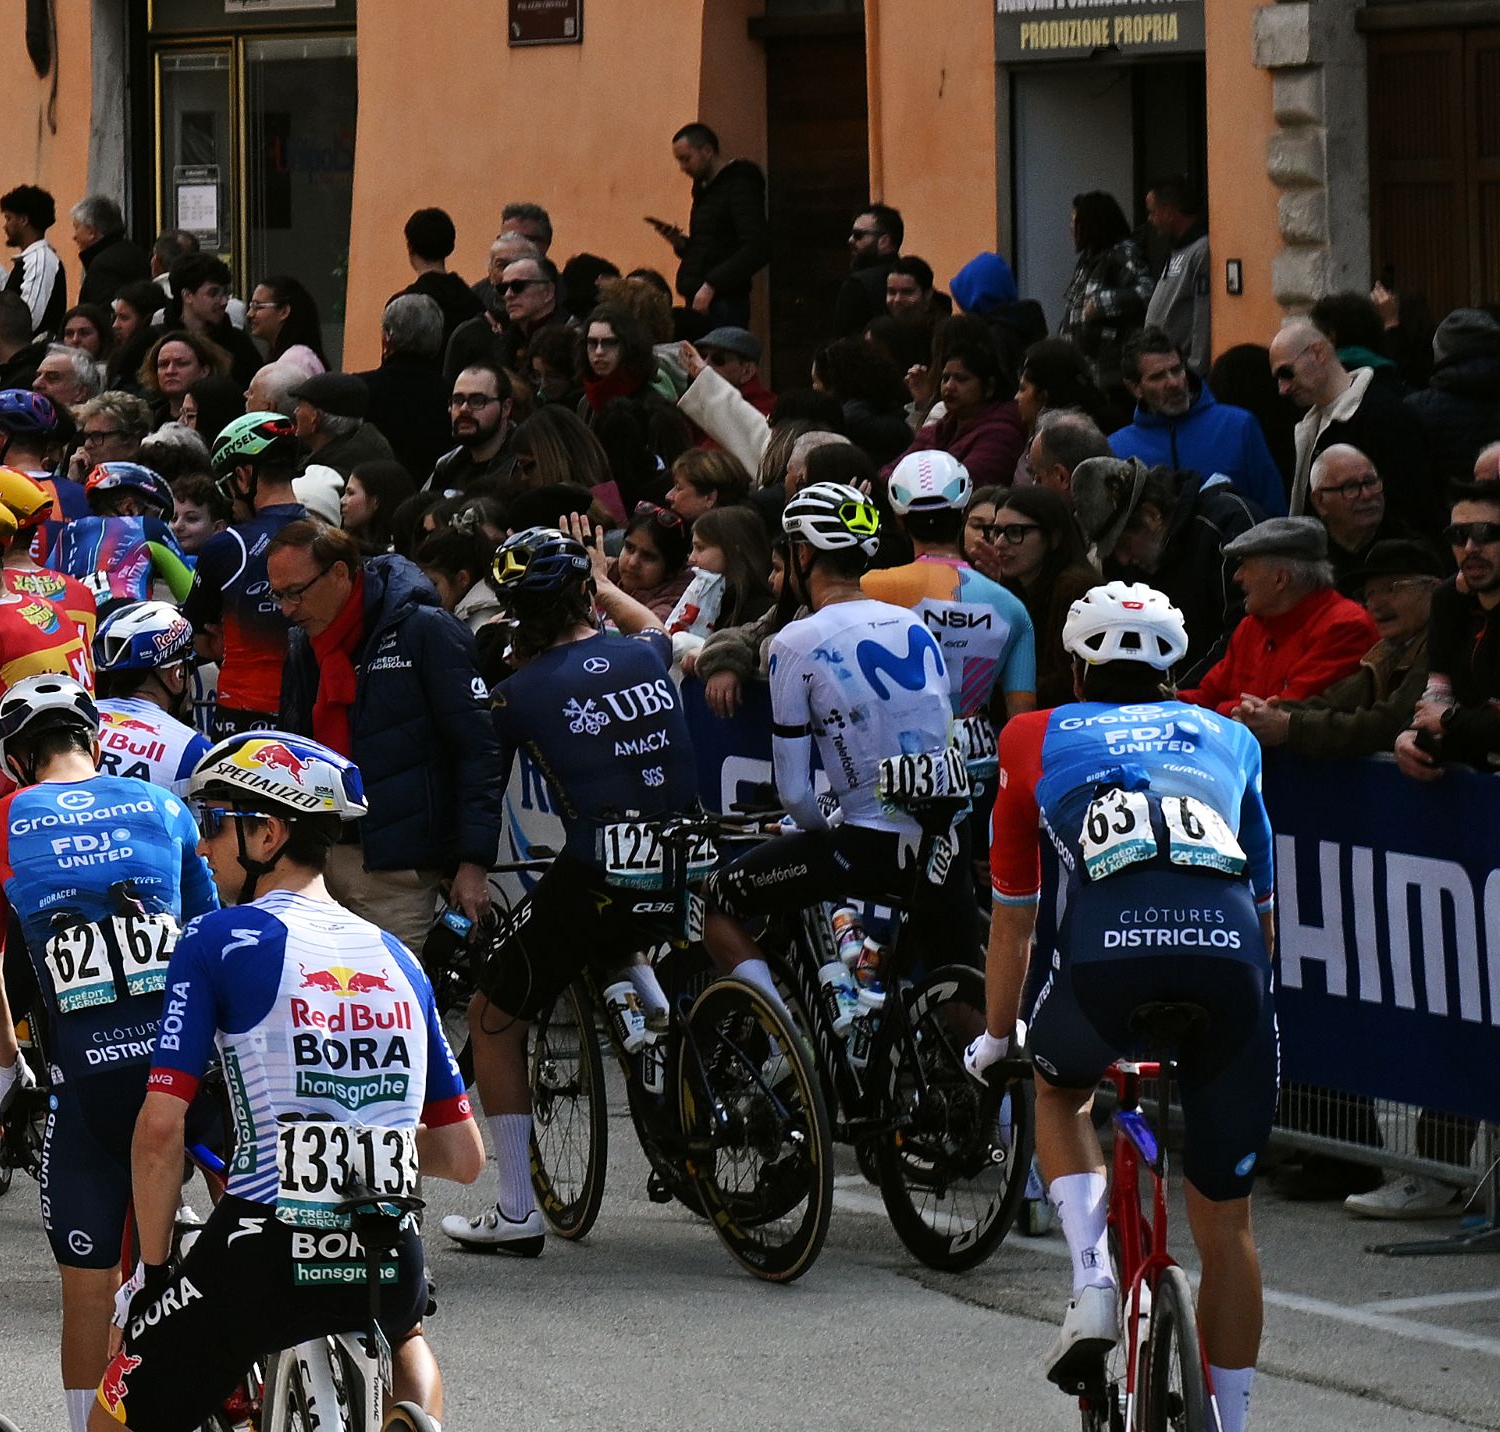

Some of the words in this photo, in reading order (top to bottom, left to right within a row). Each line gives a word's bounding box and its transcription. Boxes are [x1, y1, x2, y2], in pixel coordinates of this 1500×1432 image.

[1020, 17, 1110, 50] PRODUZIONE
[1114, 12, 1179, 44] PROPRIA
[602, 680, 675, 724] UBS
[1105, 723, 1175, 746] FDJ
[1109, 741, 1196, 756] UNITED
[642, 766, 665, 787] SGS
[11, 798, 154, 836] Groupama
[51, 834, 110, 856] FDJ
[58, 847, 134, 868] UNITED
[932, 838, 951, 880] 103
[688, 899, 703, 937] 122
[1119, 907, 1225, 925] CLÔTURES
[1104, 928, 1242, 949] DISTRICLOS
[294, 1034, 411, 1070] BORA
[41, 1115, 57, 1187] UNITED
[43, 1188, 54, 1231] FDJ
